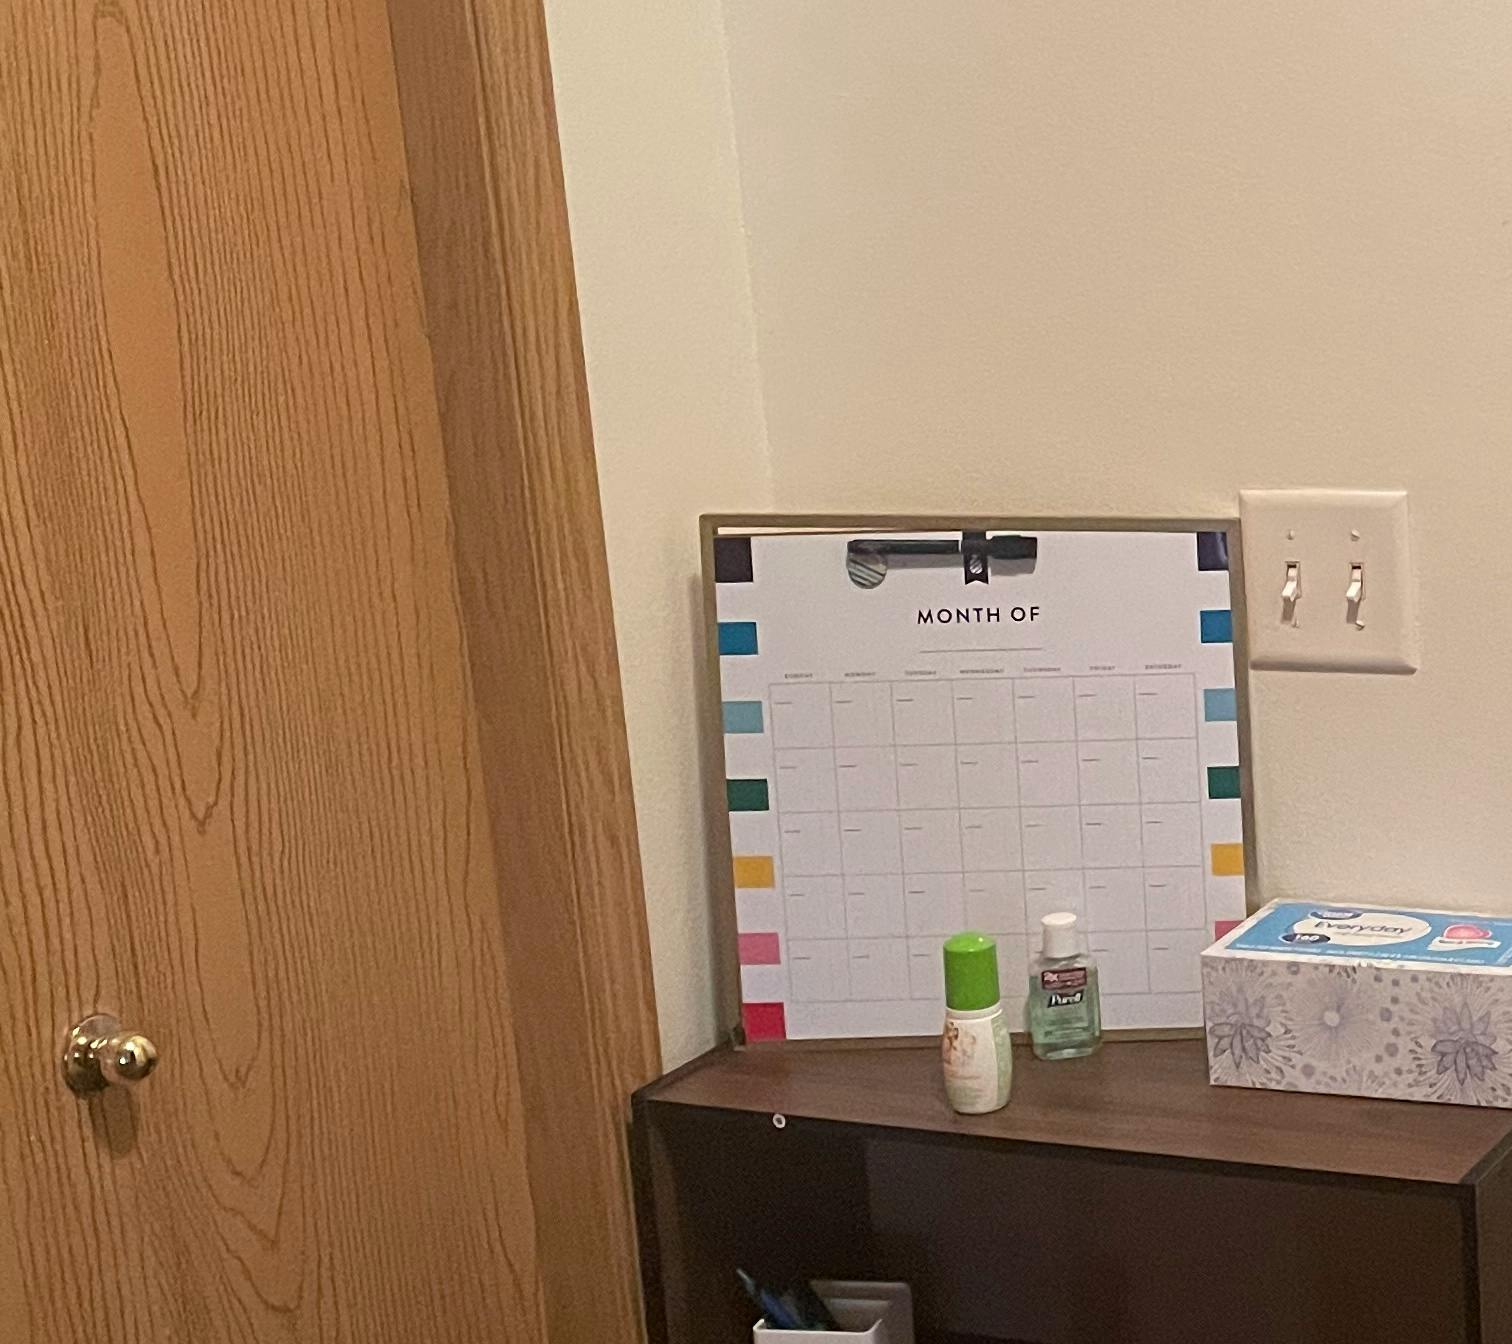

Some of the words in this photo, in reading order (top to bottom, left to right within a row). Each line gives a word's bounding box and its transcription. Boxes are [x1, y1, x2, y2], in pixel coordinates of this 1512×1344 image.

[917, 607, 1000, 625] MONTH
[1010, 606, 1040, 622] OF
[1314, 920, 1413, 934] Everyday
